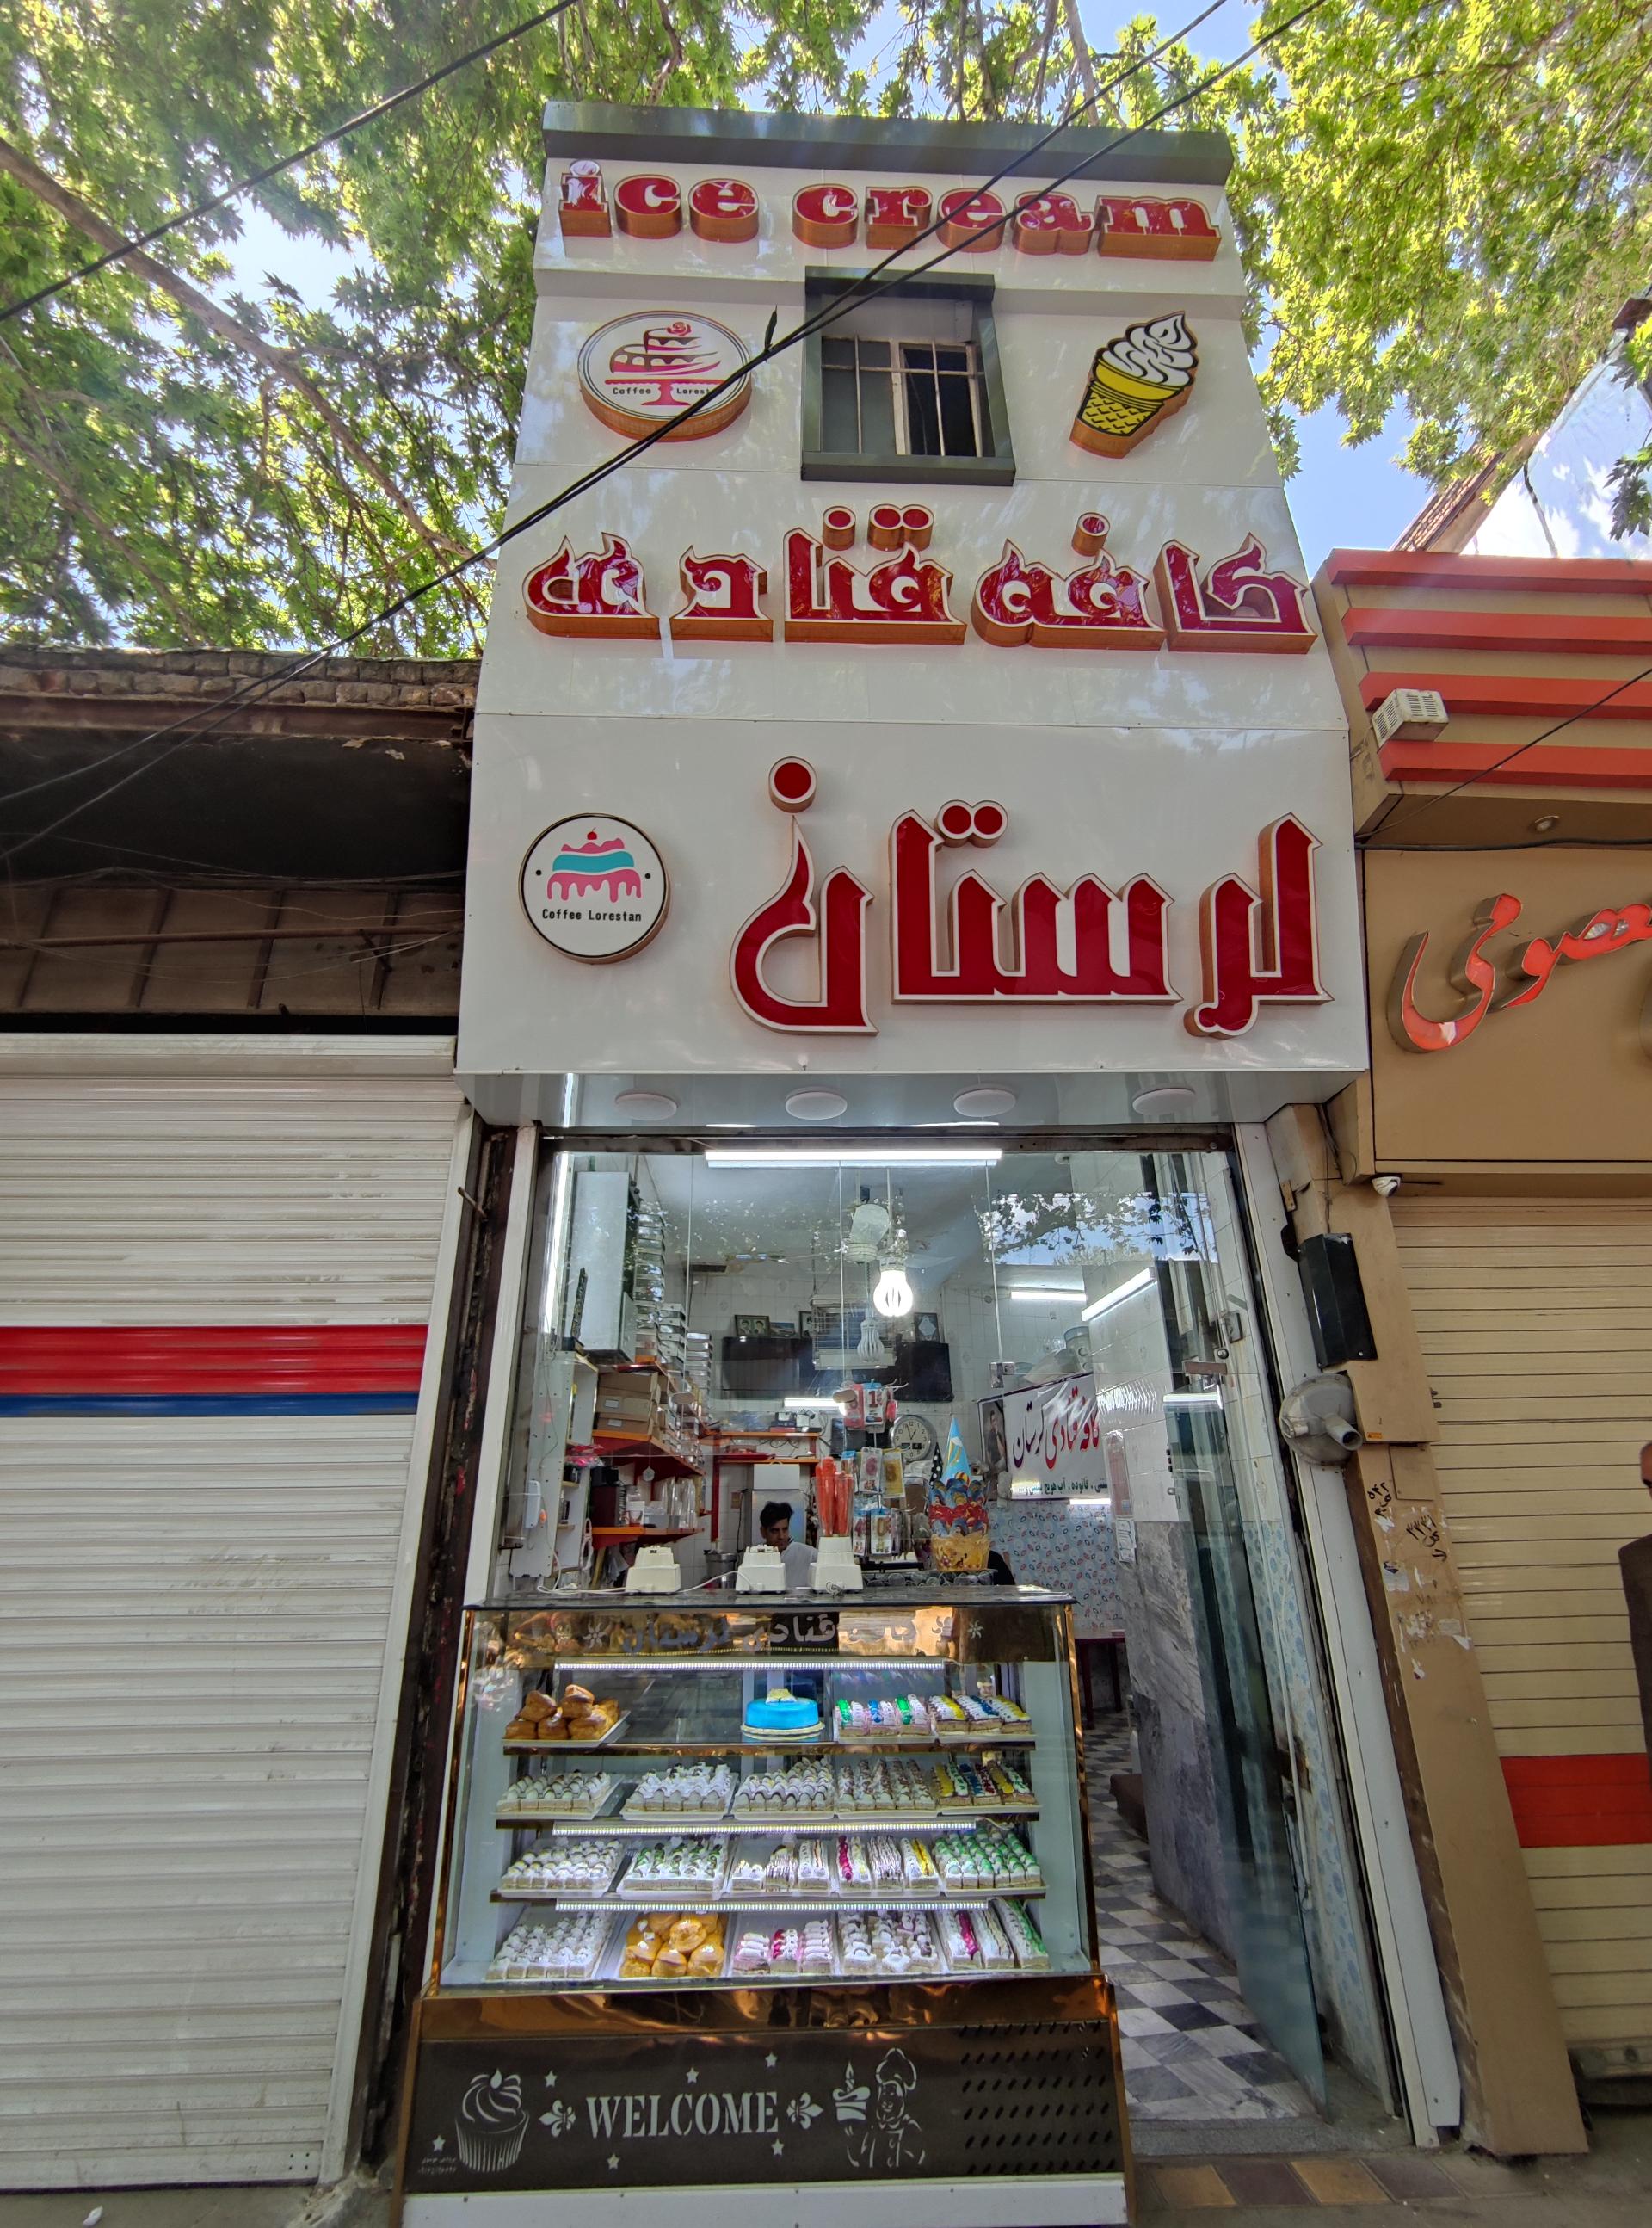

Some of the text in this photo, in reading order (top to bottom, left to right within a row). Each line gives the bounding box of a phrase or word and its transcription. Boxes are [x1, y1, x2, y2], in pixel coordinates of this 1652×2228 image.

[558, 159, 1221, 255] ice cream
[971, 512, 1318, 649] کافه
[542, 909, 642, 922] Coffee Lorestan
[729, 756, 1335, 1038] لرستان
[586, 2091, 779, 2139] WELCOME
